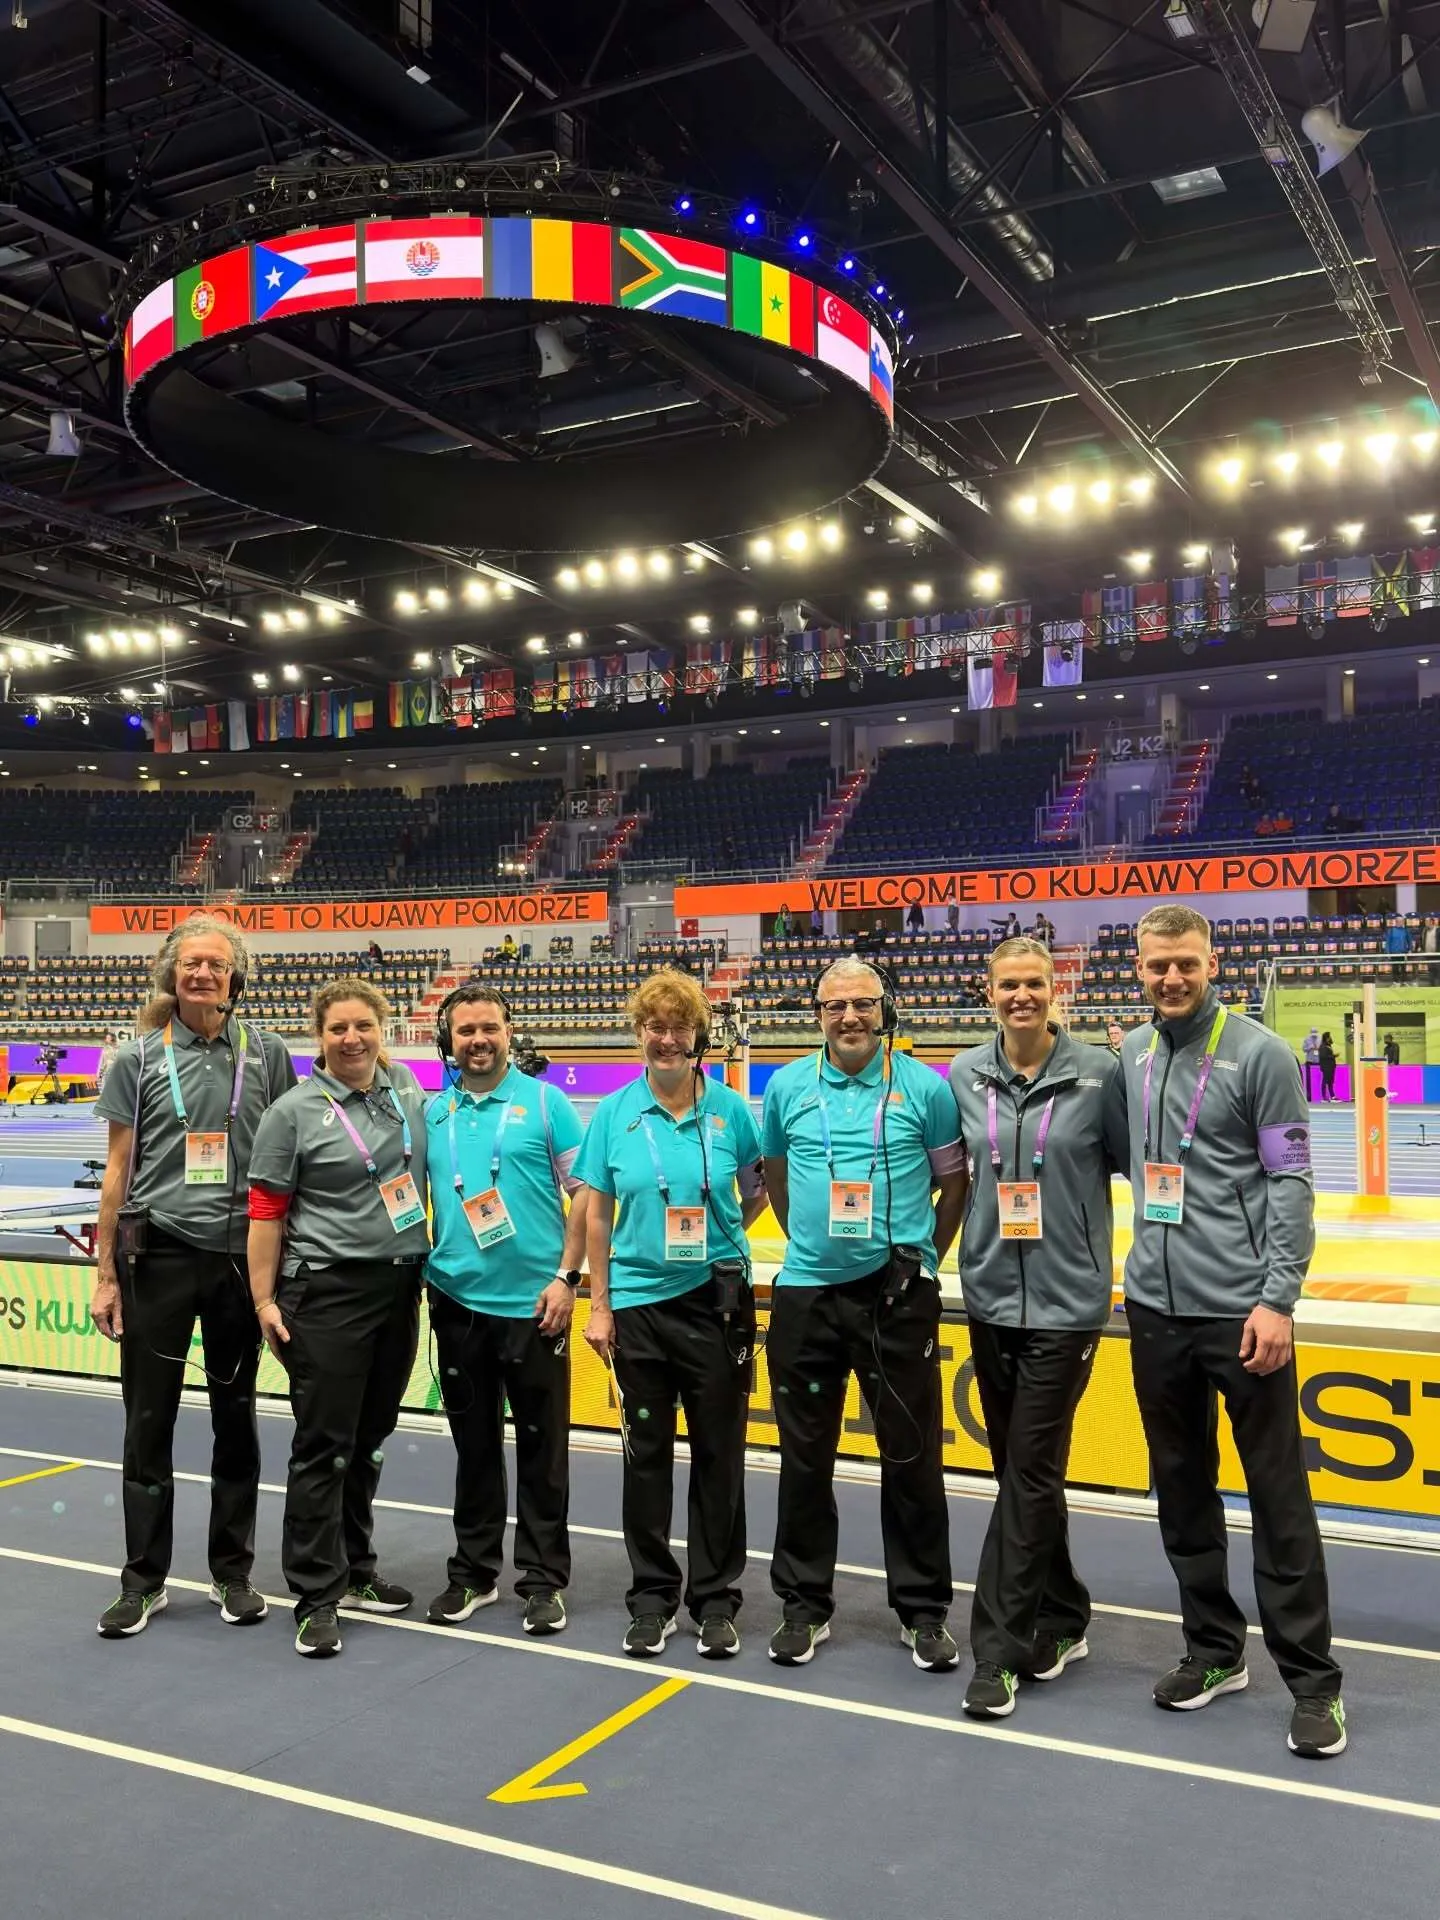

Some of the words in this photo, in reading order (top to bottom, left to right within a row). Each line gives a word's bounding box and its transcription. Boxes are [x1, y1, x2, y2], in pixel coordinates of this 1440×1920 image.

[1111, 738, 1132, 755] J2
[1140, 735, 1163, 752] K2
[571, 800, 588, 814] H2
[232, 815, 253, 828] G2
[809, 875, 978, 908] WELCOME
[988, 871, 1037, 900] TO
[1049, 861, 1210, 897] KUJAWY
[1222, 849, 1437, 889] POMORZE
[283, 906, 323, 929] TO
[332, 903, 448, 929] KUJAWY
[455, 895, 590, 925] POMORZE
[1307, 1000, 1342, 1008] ATHLETICS
